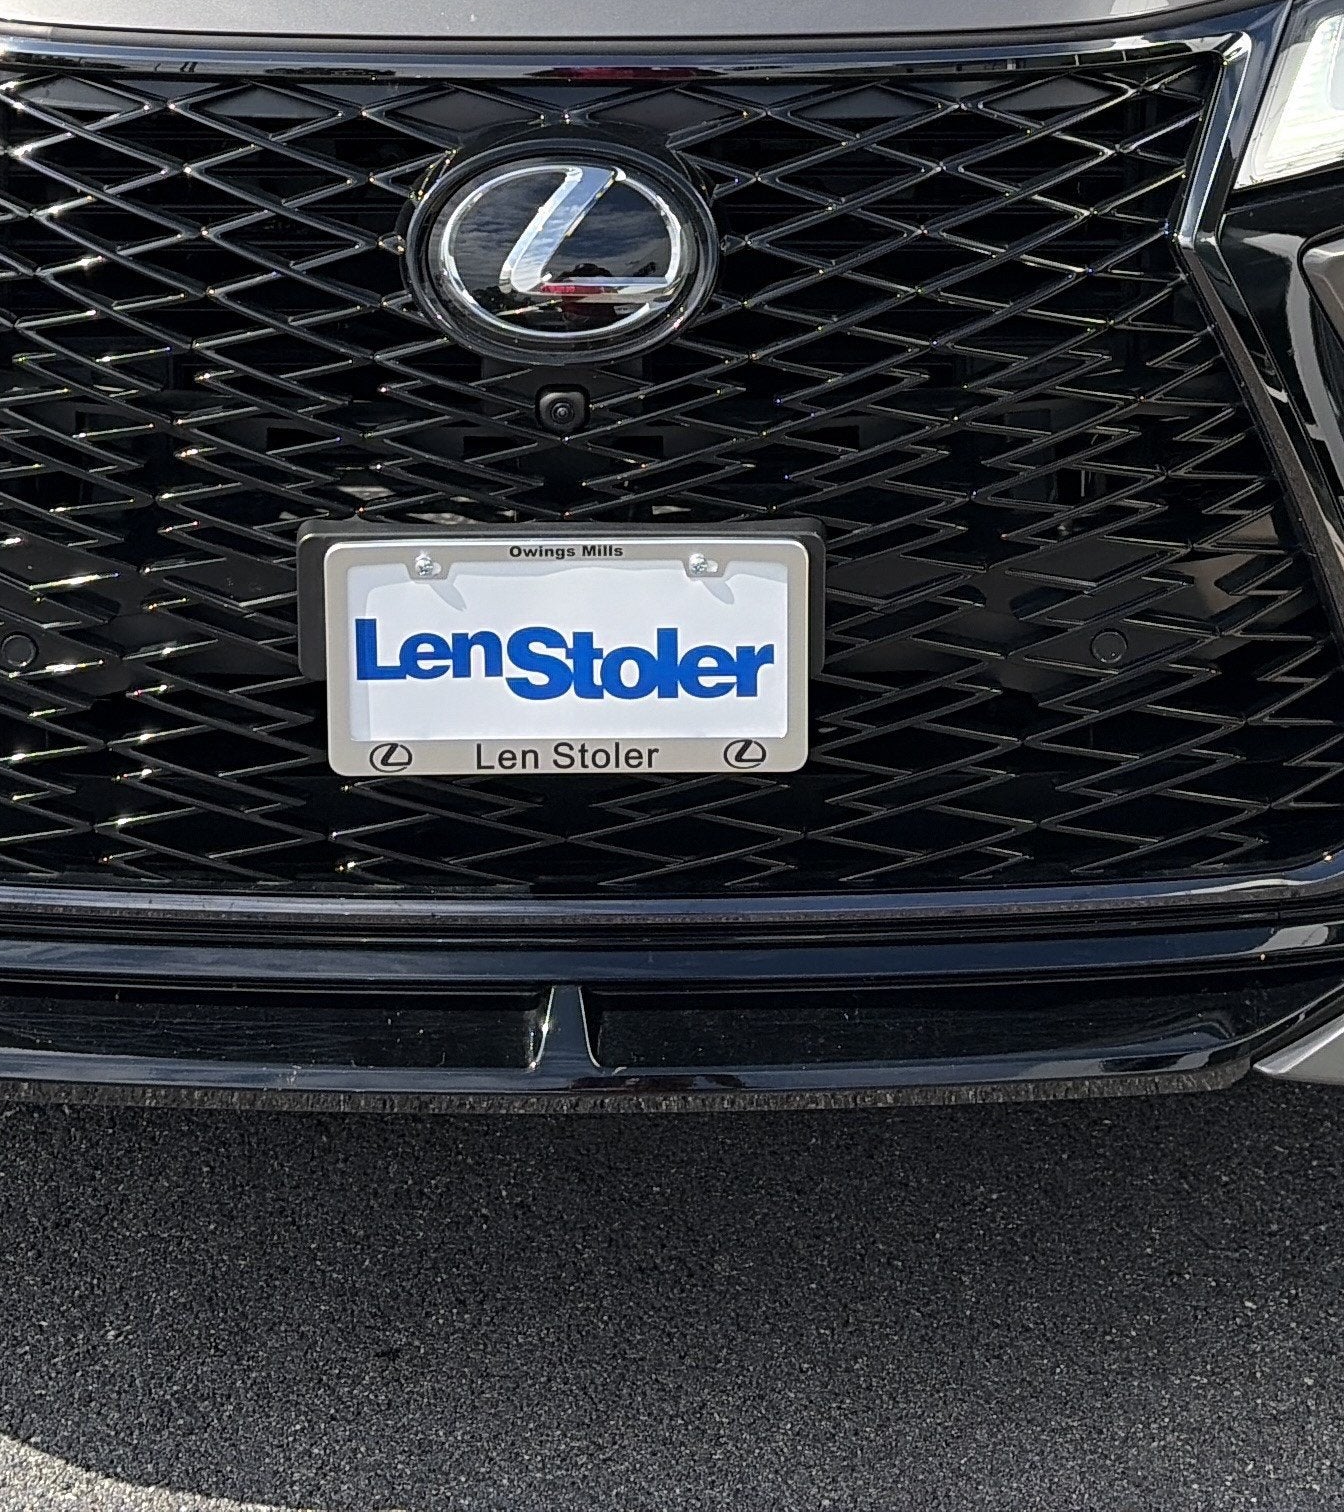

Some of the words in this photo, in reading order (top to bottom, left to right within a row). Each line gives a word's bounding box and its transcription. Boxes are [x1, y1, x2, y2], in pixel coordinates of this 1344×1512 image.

[509, 546, 575, 560] Owings
[582, 545, 623, 556] Mills
[476, 744, 539, 770] Len
[552, 741, 659, 769] Stoler
